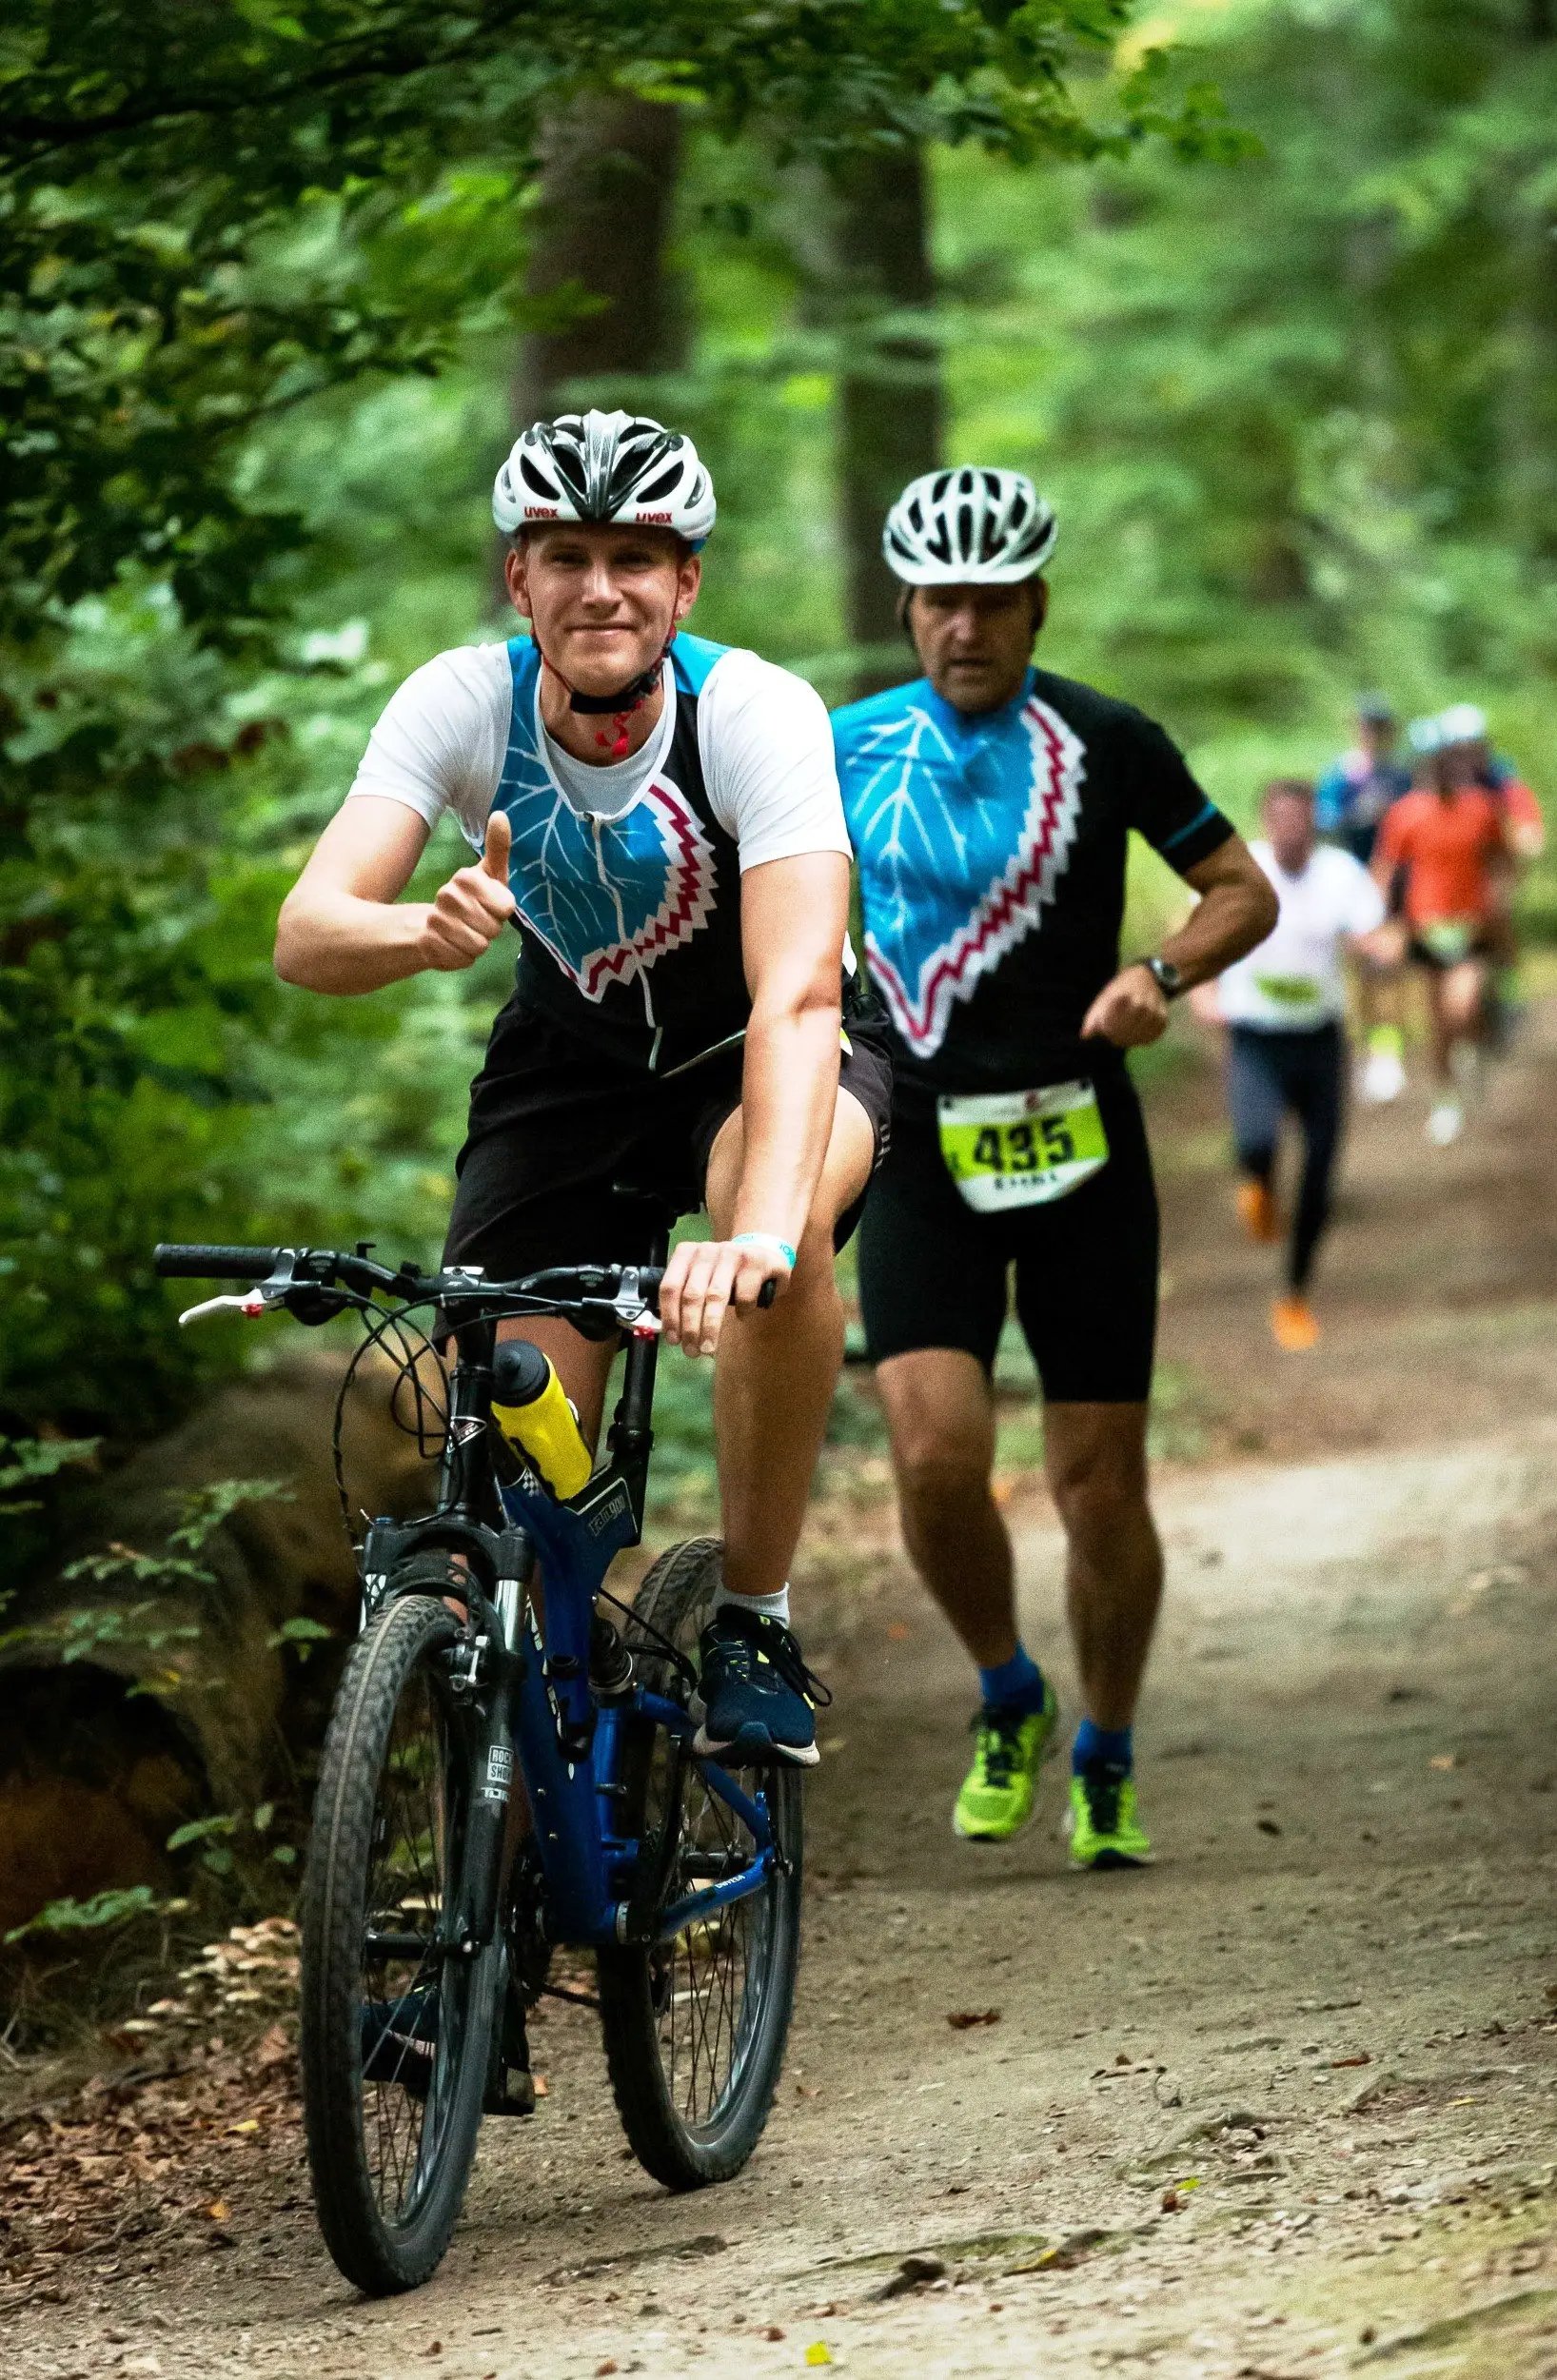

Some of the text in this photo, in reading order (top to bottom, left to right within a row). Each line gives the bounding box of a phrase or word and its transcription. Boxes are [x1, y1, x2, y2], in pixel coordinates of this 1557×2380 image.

[523, 505, 559, 519] uvex
[636, 512, 673, 523] uvex
[974, 1113, 1074, 1171] 435
